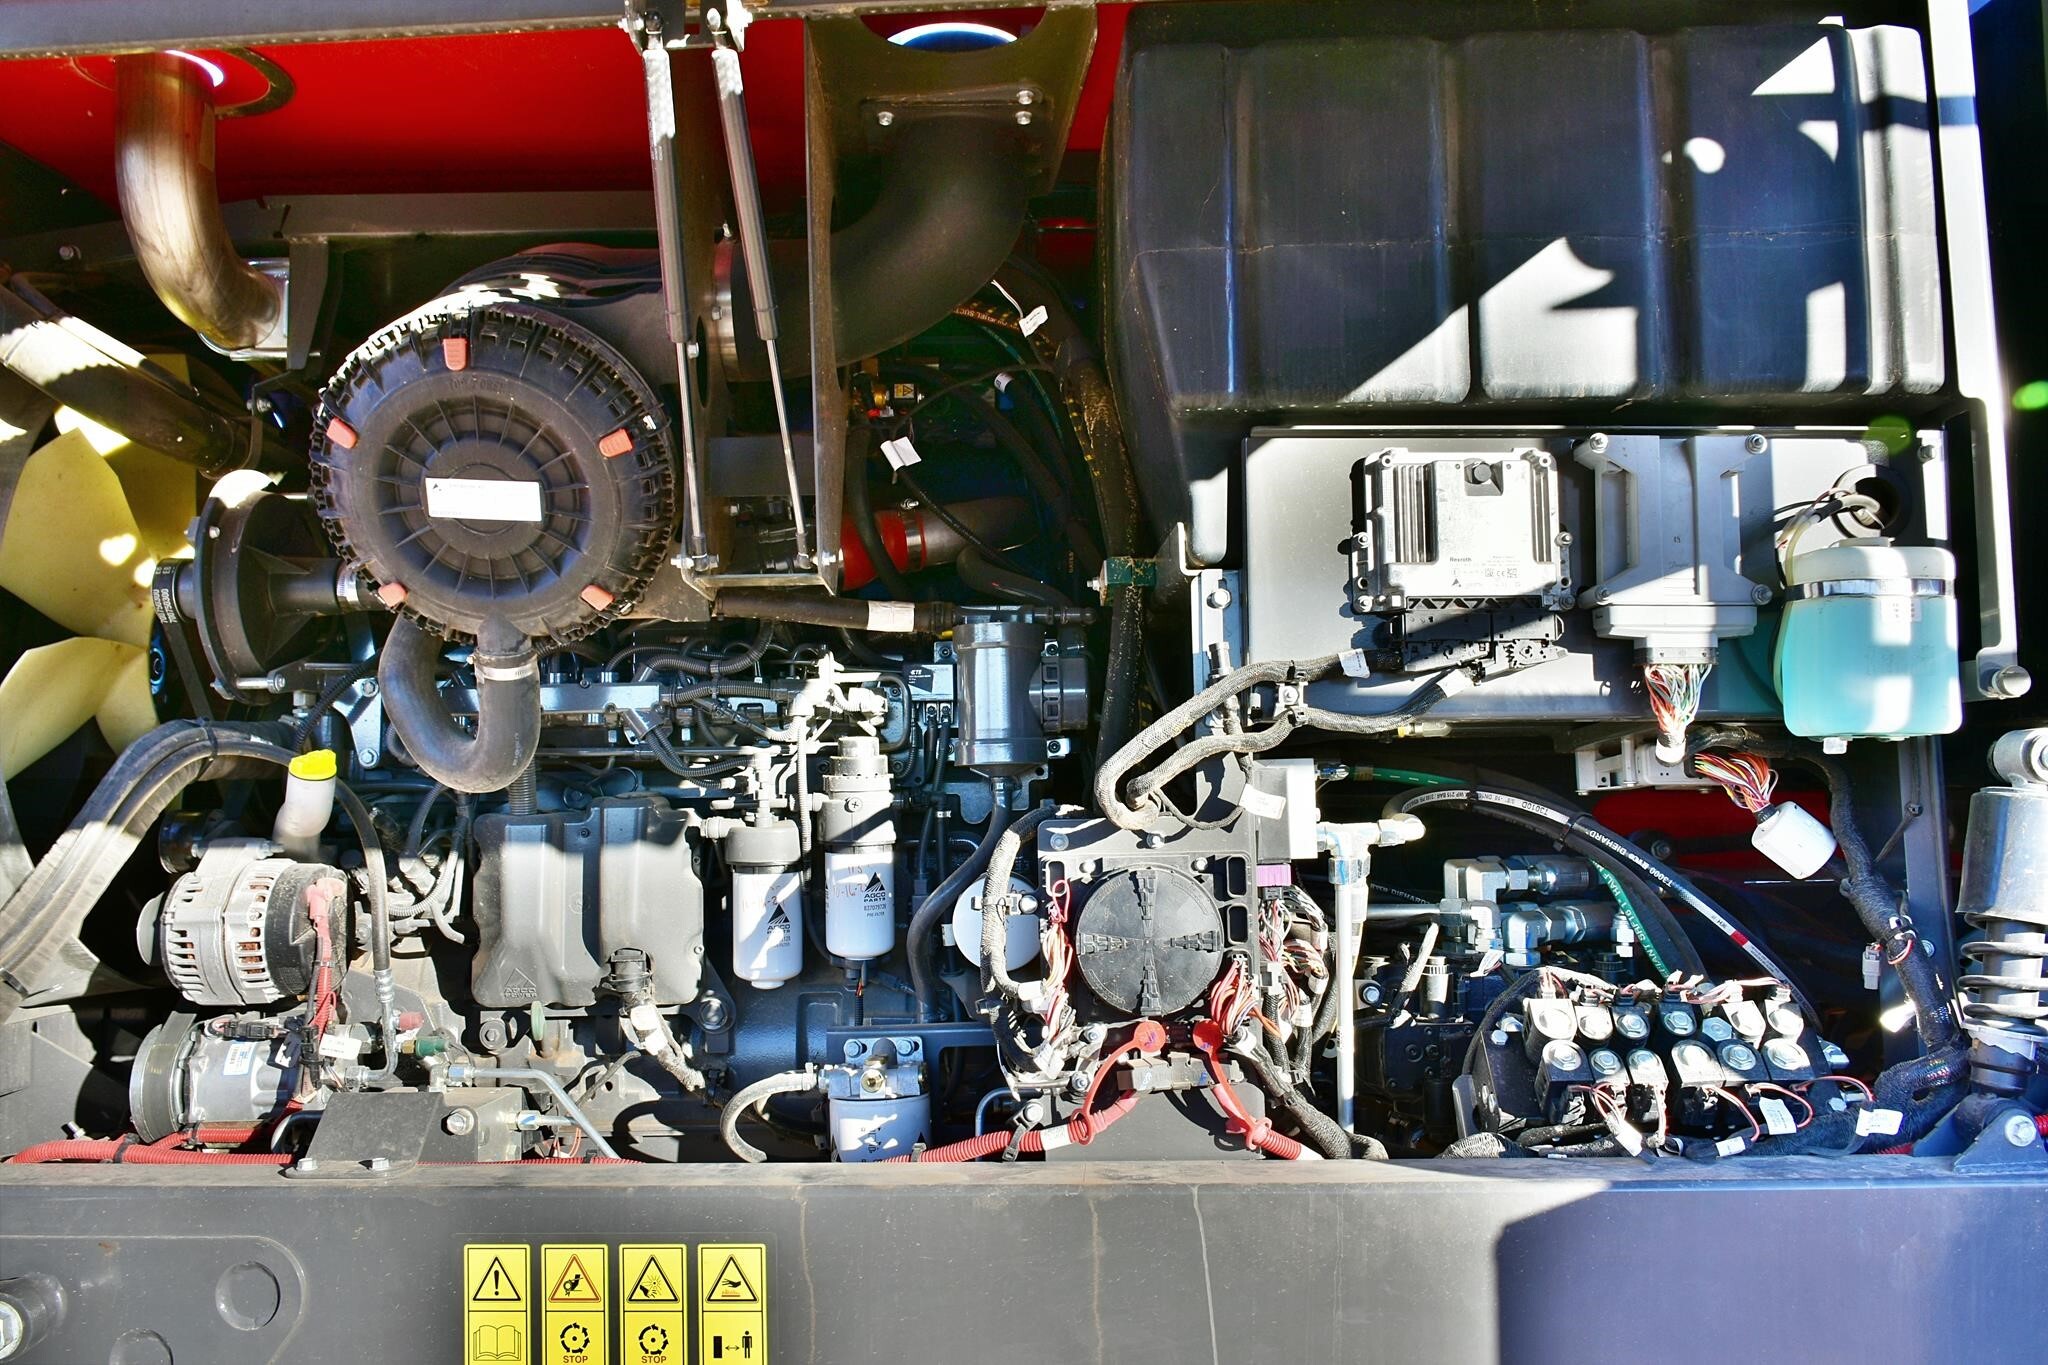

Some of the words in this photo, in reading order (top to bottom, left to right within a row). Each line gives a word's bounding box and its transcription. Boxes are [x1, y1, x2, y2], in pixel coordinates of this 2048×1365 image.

[1521, 801, 1549, 816] T3010D
[1602, 872, 1621, 898] HALF
[1649, 867, 1674, 888] T3000
[563, 1355, 588, 1364] STOP
[641, 1356, 667, 1364] STOP
